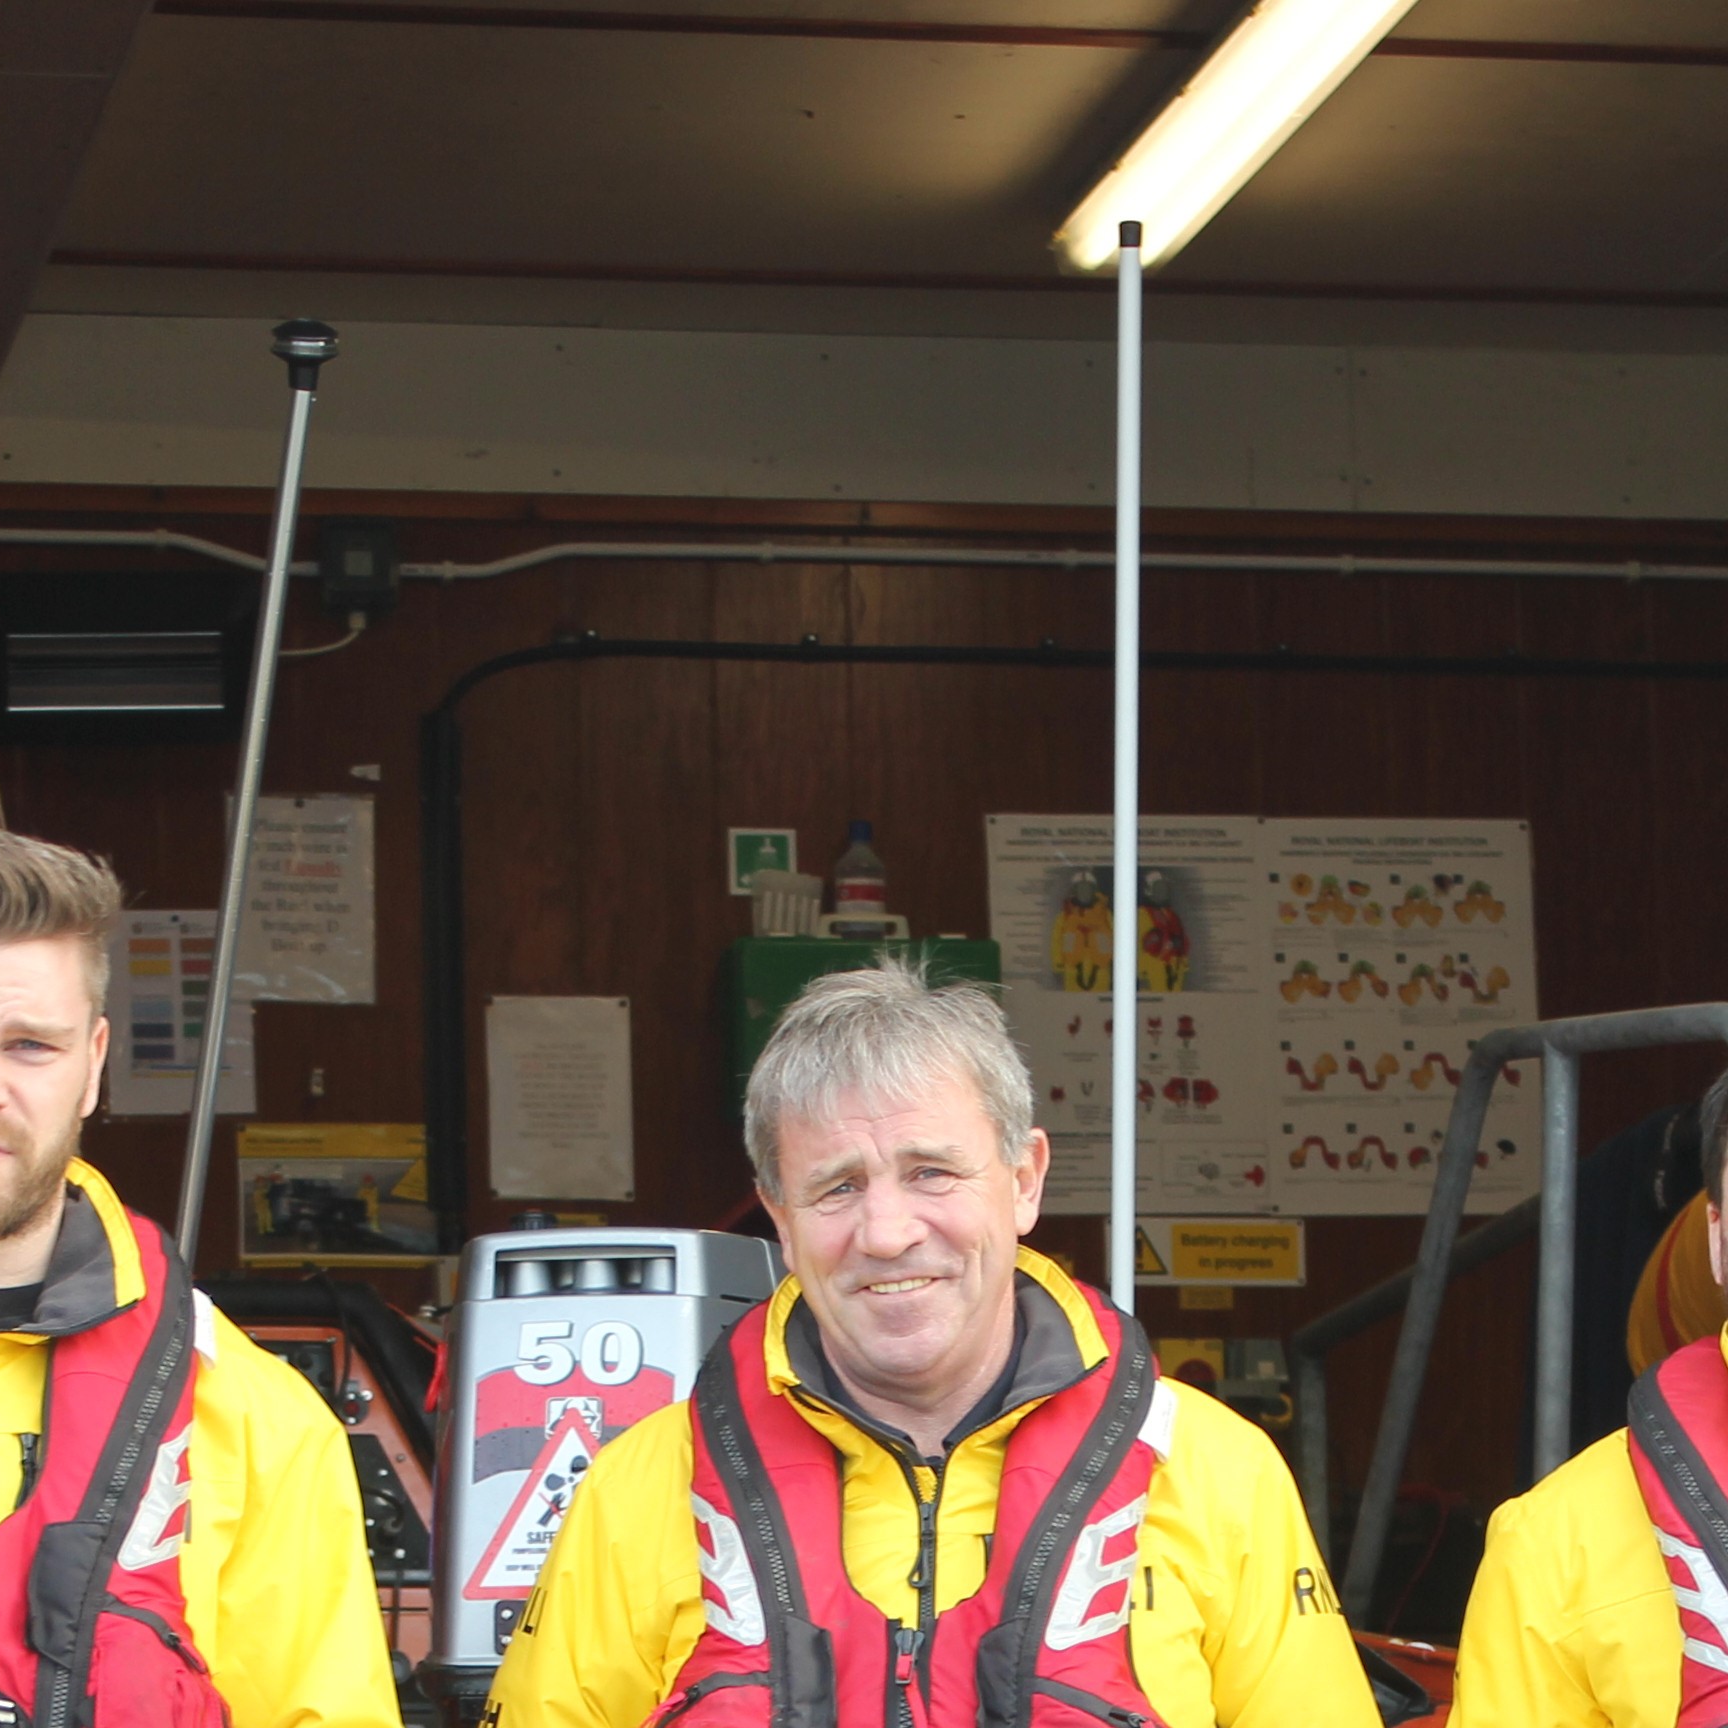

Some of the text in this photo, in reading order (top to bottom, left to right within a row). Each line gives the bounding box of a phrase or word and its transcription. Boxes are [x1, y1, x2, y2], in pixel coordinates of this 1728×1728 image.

[1180, 1233, 1290, 1251] Battery charging
[1198, 1256, 1275, 1271] in progress
[513, 1320, 645, 1386] 50
